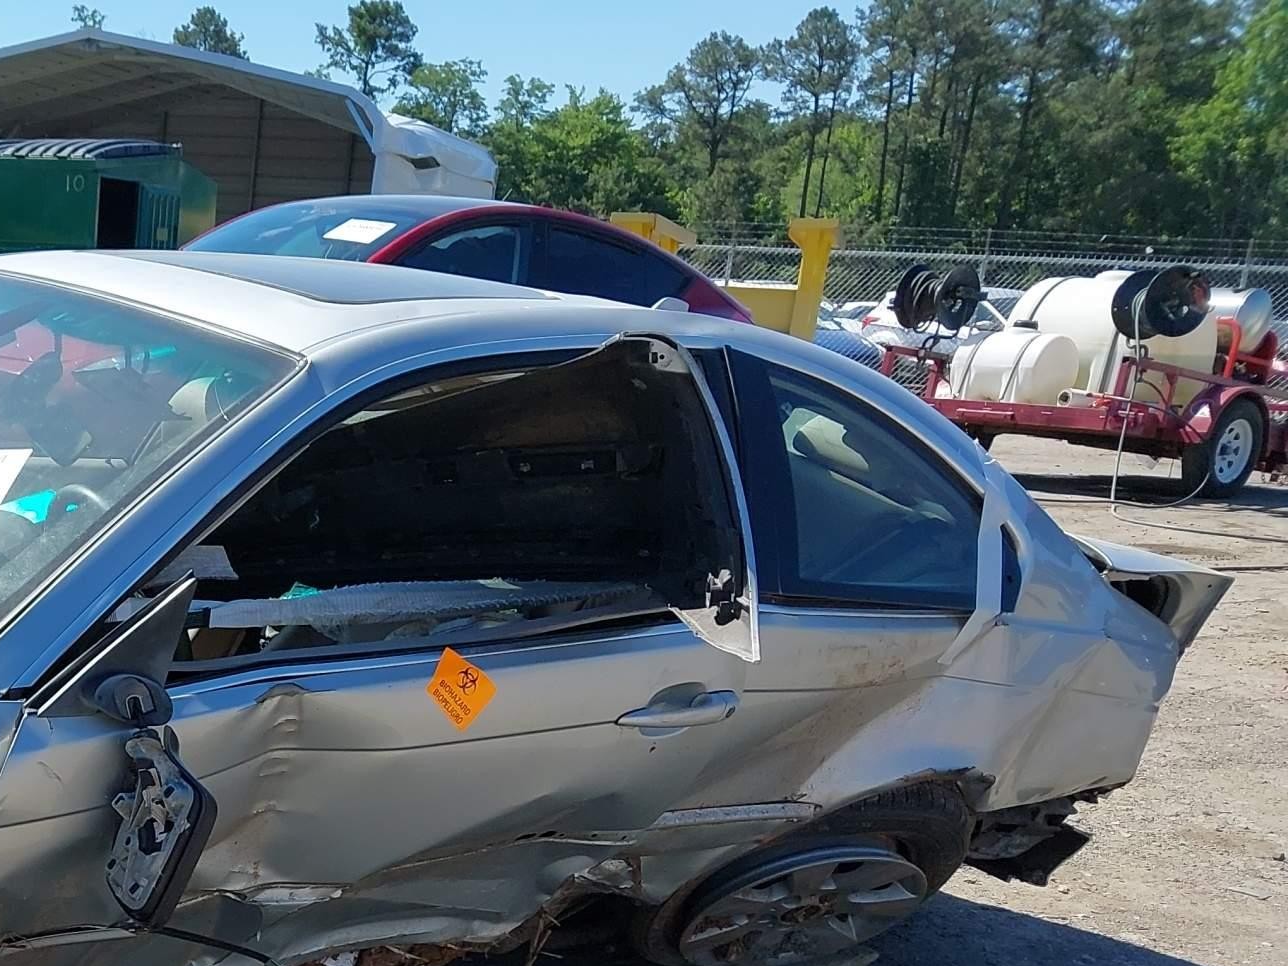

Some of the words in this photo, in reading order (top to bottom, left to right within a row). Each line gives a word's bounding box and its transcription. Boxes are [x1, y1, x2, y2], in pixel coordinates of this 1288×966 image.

[66, 174, 85, 193] 10
[432, 688, 464, 725] BIOPELIGRO
[439, 679, 472, 716] BIOHAZARD
